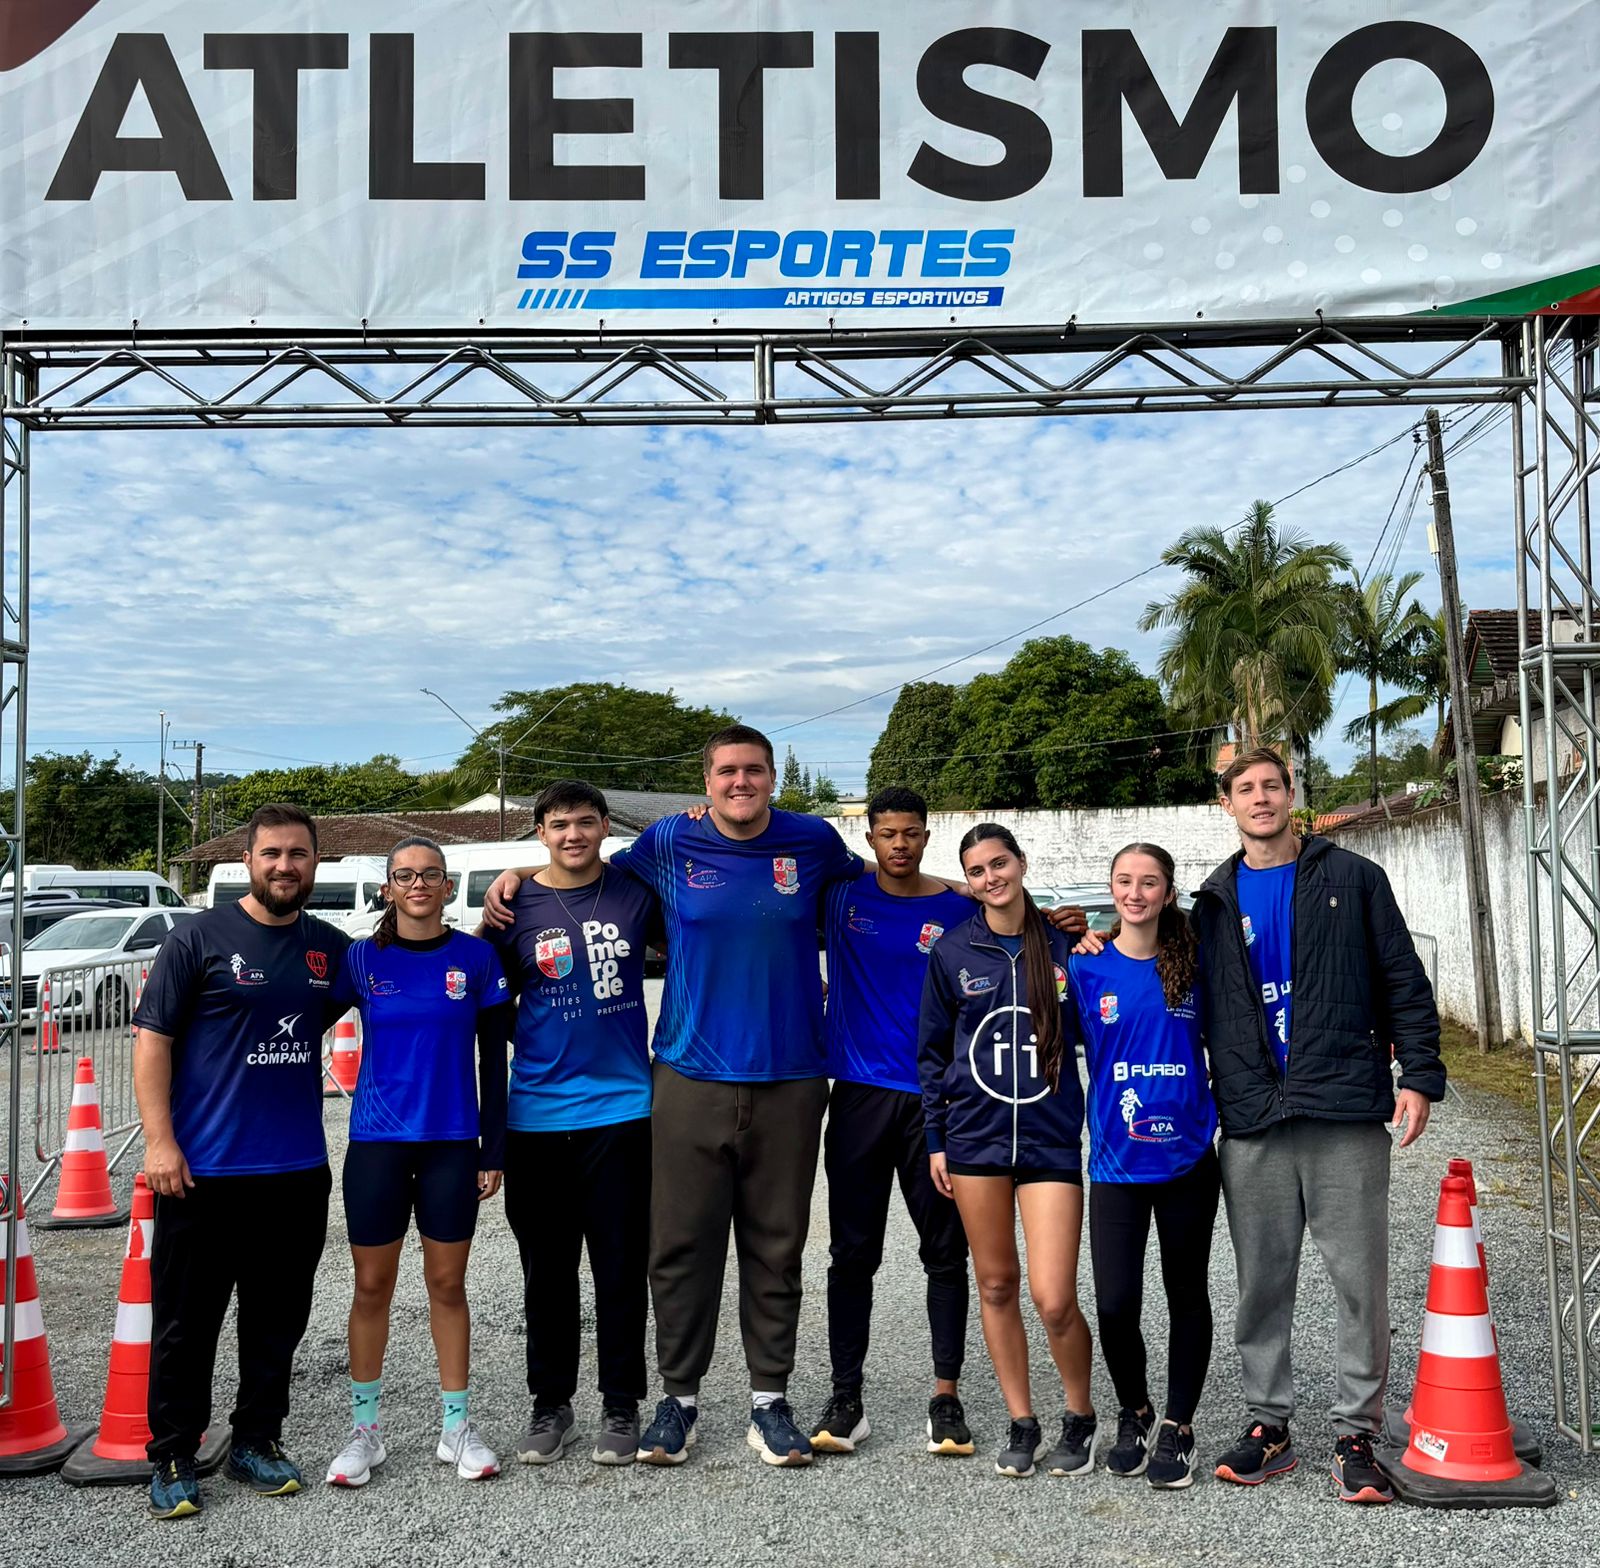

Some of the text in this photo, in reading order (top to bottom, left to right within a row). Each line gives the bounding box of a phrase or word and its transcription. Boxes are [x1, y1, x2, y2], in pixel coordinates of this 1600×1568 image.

[45, 20, 1496, 201] ATLETISMO
[517, 228, 1016, 279] SS ESPORTES
[784, 290, 990, 306] ARTIGOS ESPORTIVOS
[699, 873, 719, 882] APA
[582, 920, 620, 944] Po
[587, 939, 631, 962] me
[539, 983, 578, 996] Sempre
[593, 975, 624, 1000] de
[973, 979, 991, 989] APA
[551, 996, 581, 1008] Alles
[597, 1000, 639, 1016] PREFEITURA
[563, 1009, 583, 1022] gut
[257, 1041, 309, 1052] SPORT
[246, 1051, 312, 1065] COMPANY
[1149, 1122, 1174, 1133] APA
